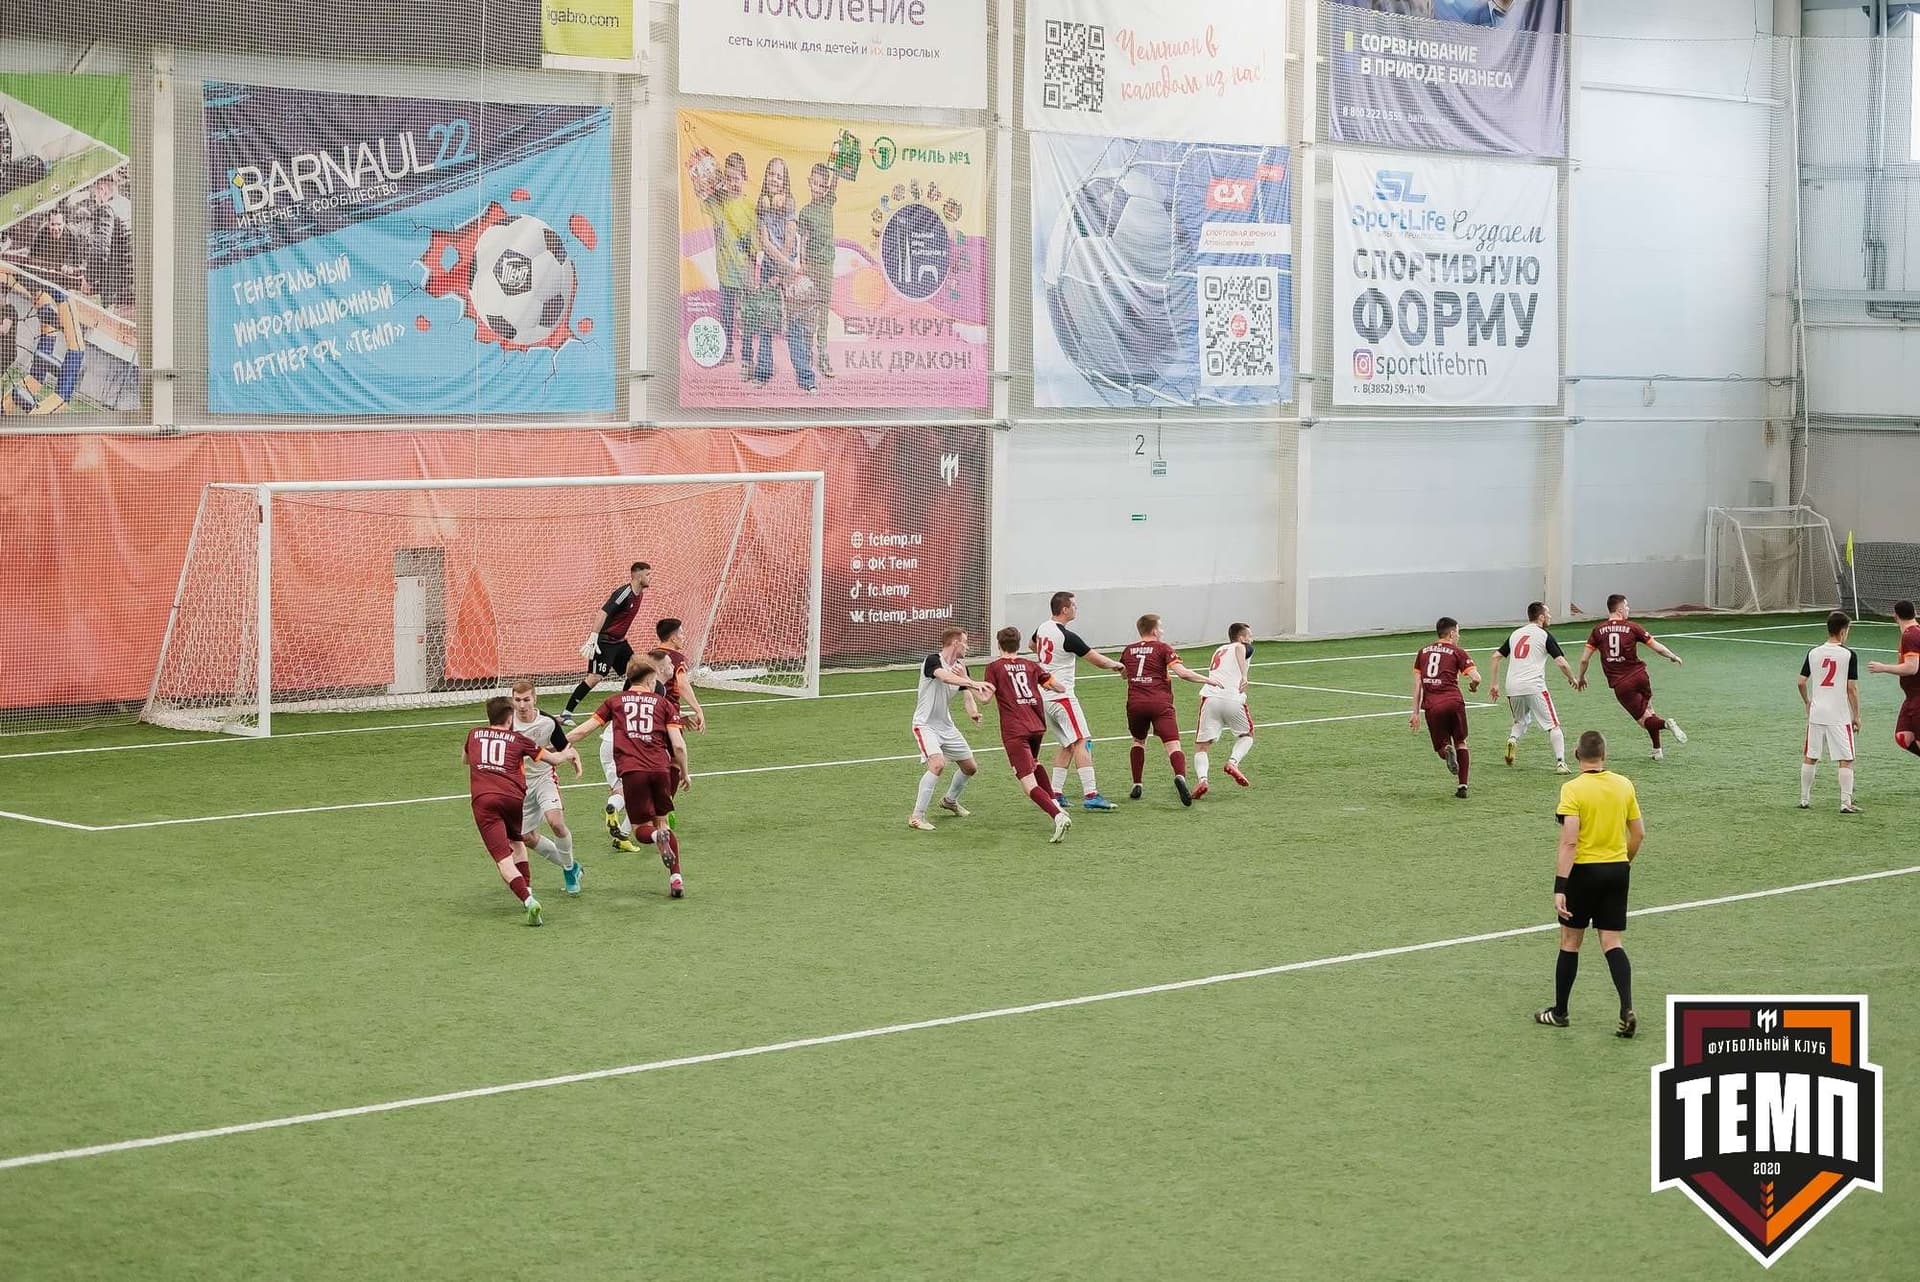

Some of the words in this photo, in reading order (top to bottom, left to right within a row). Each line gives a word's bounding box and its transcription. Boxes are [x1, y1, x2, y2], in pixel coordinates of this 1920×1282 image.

[728, 34, 753, 47] сеть
[756, 37, 797, 51] клиник
[800, 41, 822, 53] для
[825, 40, 859, 55] детей
[1361, 33, 1479, 64] СОРЕВНОВАНИЕ
[1121, 65, 1200, 101] каждом
[1206, 70, 1226, 97] из
[1360, 57, 1370, 75] В
[1375, 58, 1446, 85] ПРИРОДЕ
[1449, 67, 1513, 89] БИЗНЕСА
[902, 147, 945, 163] ГРИЛЬ
[1352, 203, 1447, 232] SportLife
[1452, 208, 1546, 252] Создаем
[232, 252, 351, 306] ГЕНЕРАЛЬНЫЙ
[1352, 247, 1540, 286] СПОРТИВНУЮ
[233, 280, 394, 348] ИНФОРМАЦИОННЫЙ
[1352, 287, 1539, 348] ФОРМУ
[843, 316, 904, 340] БУДЬ
[233, 345, 309, 385] ПАРТНЕР
[312, 335, 342, 363] ФК
[346, 321, 406, 354] «ТЕМП»
[844, 349, 883, 369] КАК
[889, 350, 972, 373] ДРАКОН!
[1376, 351, 1489, 380] sportlifebrn
[1362, 383, 1393, 395] 8(3852)
[1135, 434, 1145, 455] 2
[869, 533, 922, 548] fctemp.ru
[868, 557, 886, 571] ФК
[890, 556, 918, 570] Темп
[868, 583, 910, 597] fc.temp
[868, 604, 953, 623] fctemp_barnaul
[1513, 634, 1531, 660] 6
[1608, 632, 1620, 657] 9
[597, 662, 607, 673] 16
[1136, 654, 1146, 677] 7
[1426, 652, 1441, 678] 8
[1820, 658, 1838, 688] 2
[1008, 671, 1034, 699] 18
[624, 702, 655, 734] 25
[480, 738, 507, 767] 10
